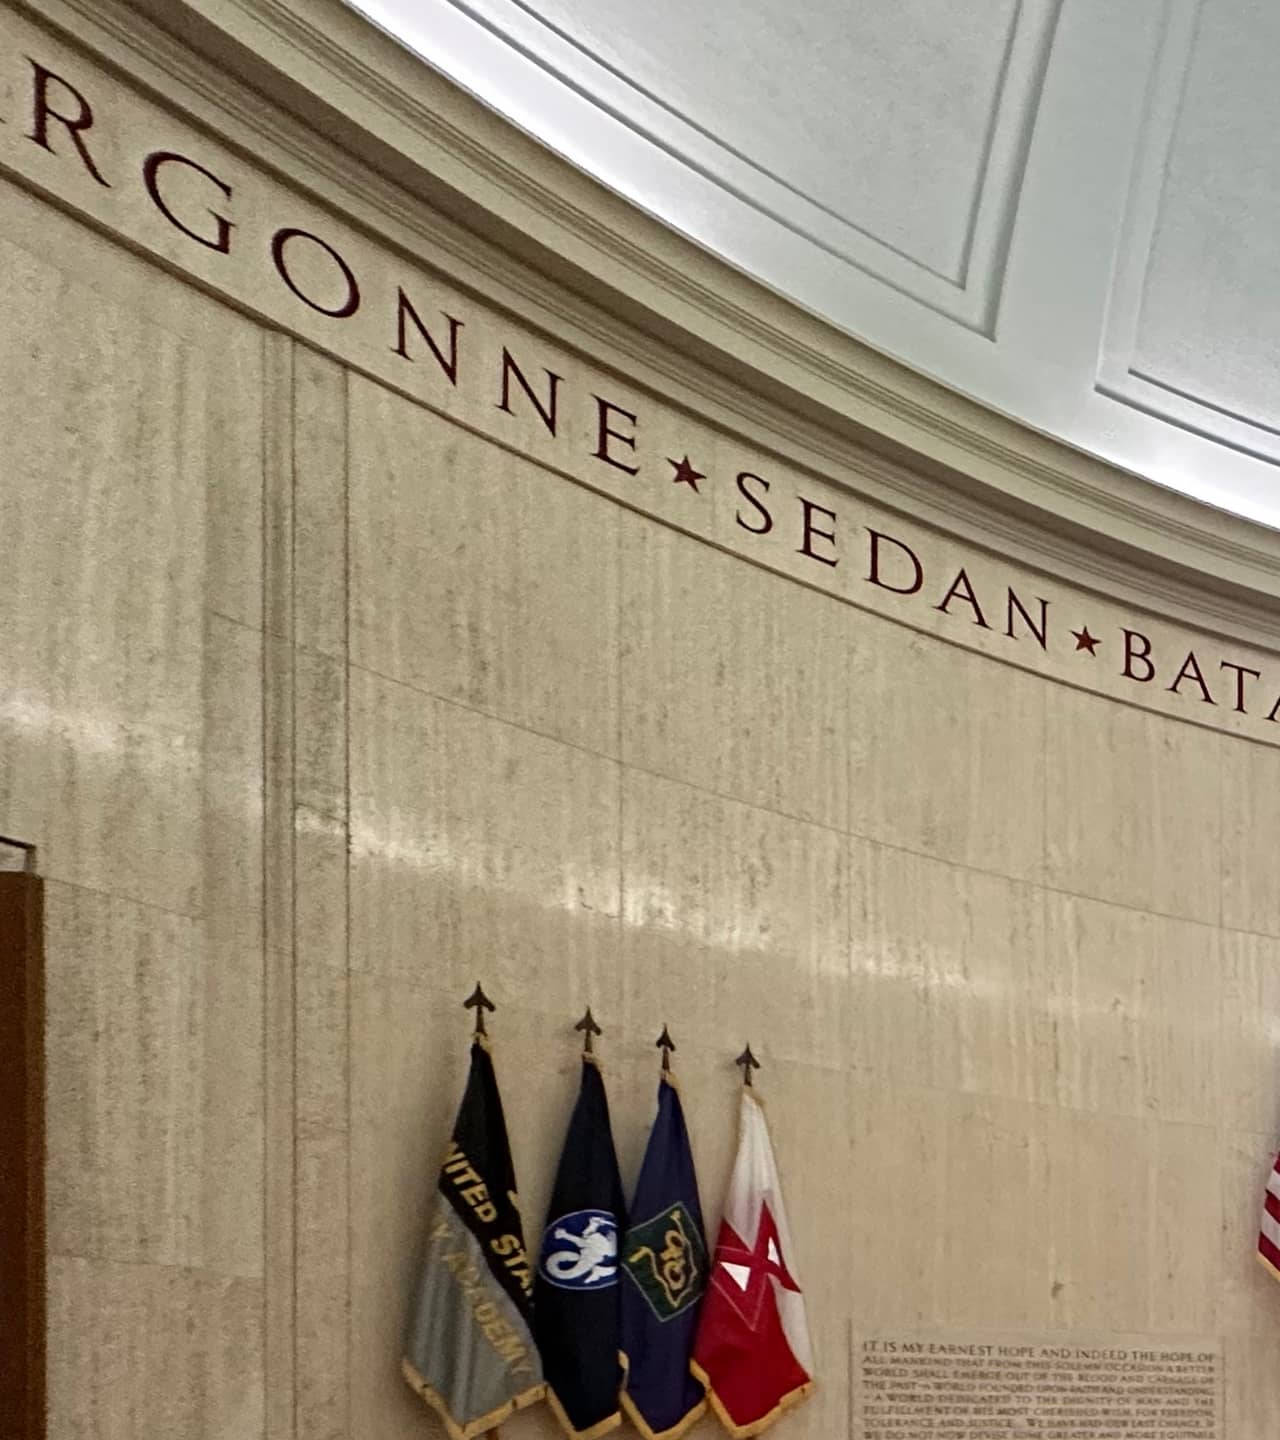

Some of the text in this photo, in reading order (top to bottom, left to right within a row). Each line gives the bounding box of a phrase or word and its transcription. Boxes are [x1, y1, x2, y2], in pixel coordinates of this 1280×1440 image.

[0, 54, 640, 476] RGONNE
[735, 472, 1050, 650] SEDAN
[864, 1341, 877, 1352] IT
[884, 1342, 897, 1352] IS
[902, 1342, 922, 1354] MY
[930, 1343, 993, 1356] EARNEST
[998, 1345, 1035, 1357] HOPE
[1041, 1347, 1071, 1358] AND
